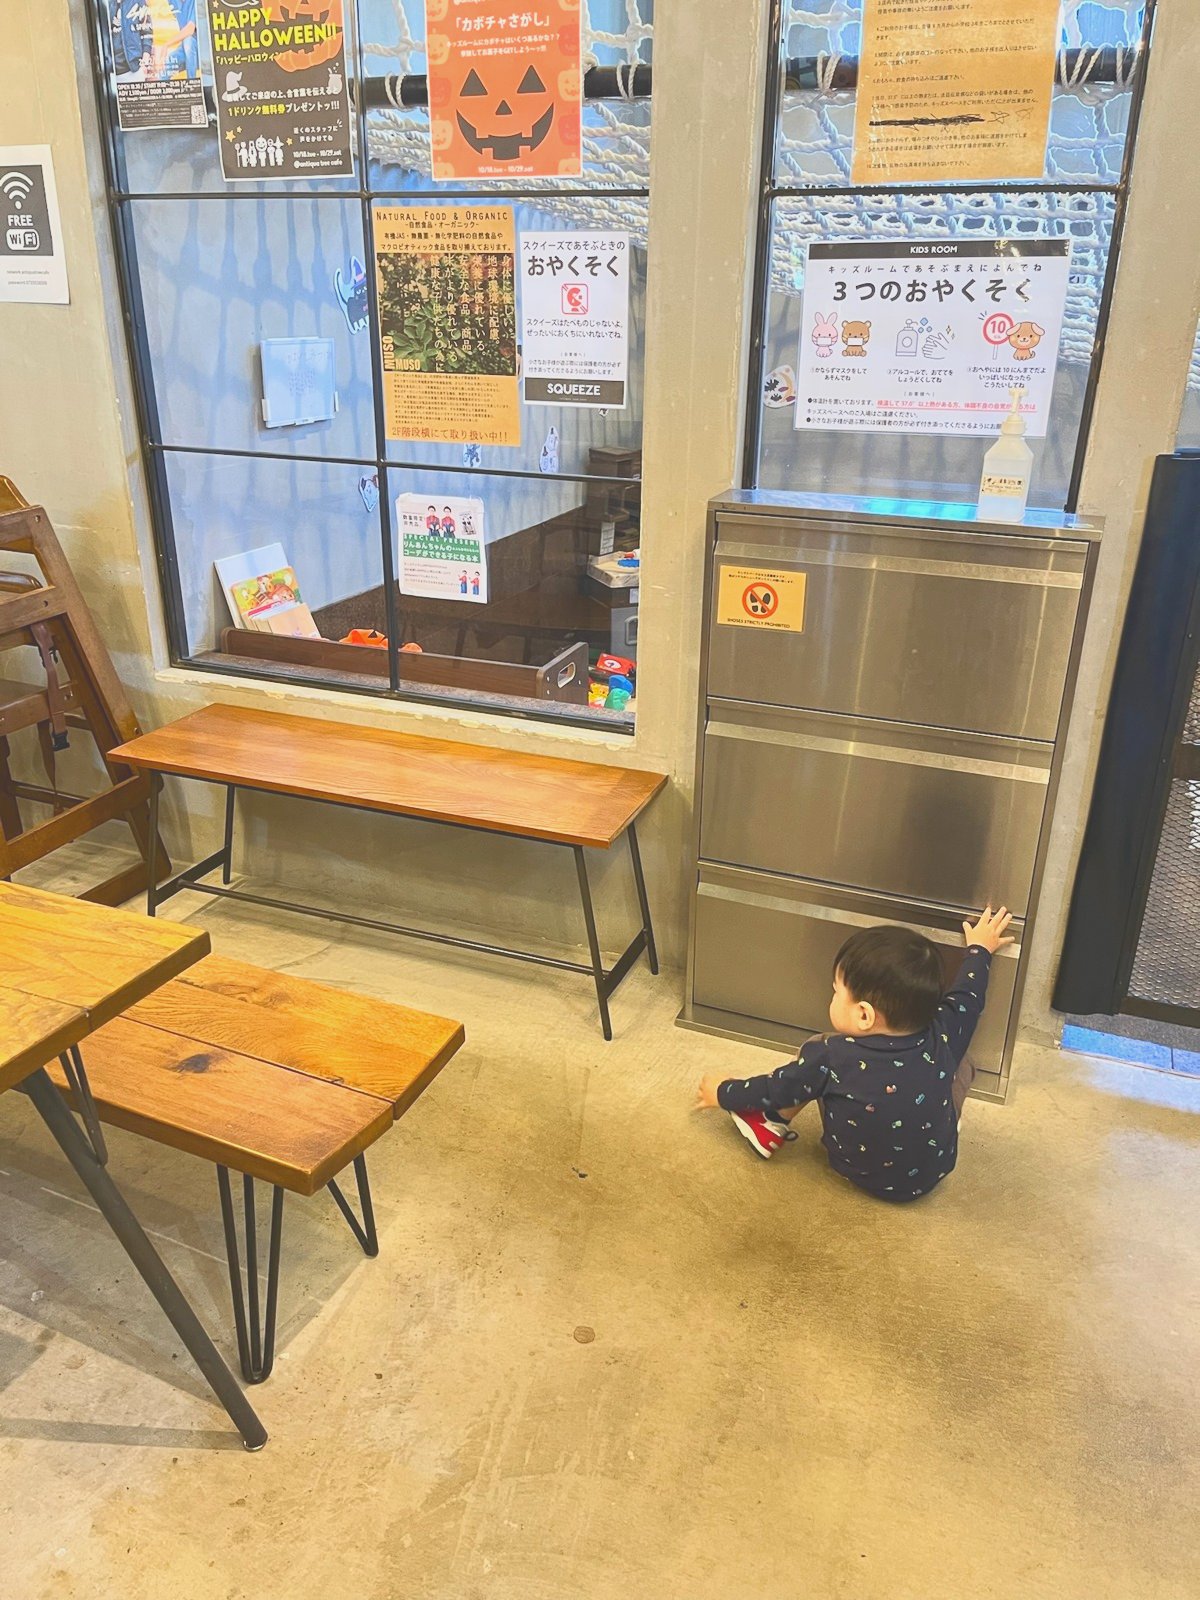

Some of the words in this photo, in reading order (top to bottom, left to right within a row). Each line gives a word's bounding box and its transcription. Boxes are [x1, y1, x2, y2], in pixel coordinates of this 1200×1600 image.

[212, 7, 273, 30] HAPPY
[455, 12, 550, 31] 「カボチャさがし」
[214, 22, 337, 51] HALLOWEEN!!
[7, 214, 34, 227] FREE
[454, 212, 459, 220] &
[523, 240, 625, 251] スクイーズであそぶときの
[910, 246, 929, 254] KIDS
[931, 245, 958, 254] ROOM
[527, 255, 619, 277] おやくそく
[828, 264, 1042, 273] キッズルームであそぶまえによんでね
[833, 278, 1031, 302] 3つのおやくそく
[991, 320, 1006, 334] 10
[382, 336, 395, 370] MUSO
[396, 359, 421, 371] MUSO
[898, 376, 942, 384] しょうどくしてね
[547, 383, 601, 396] SQUEEZE
